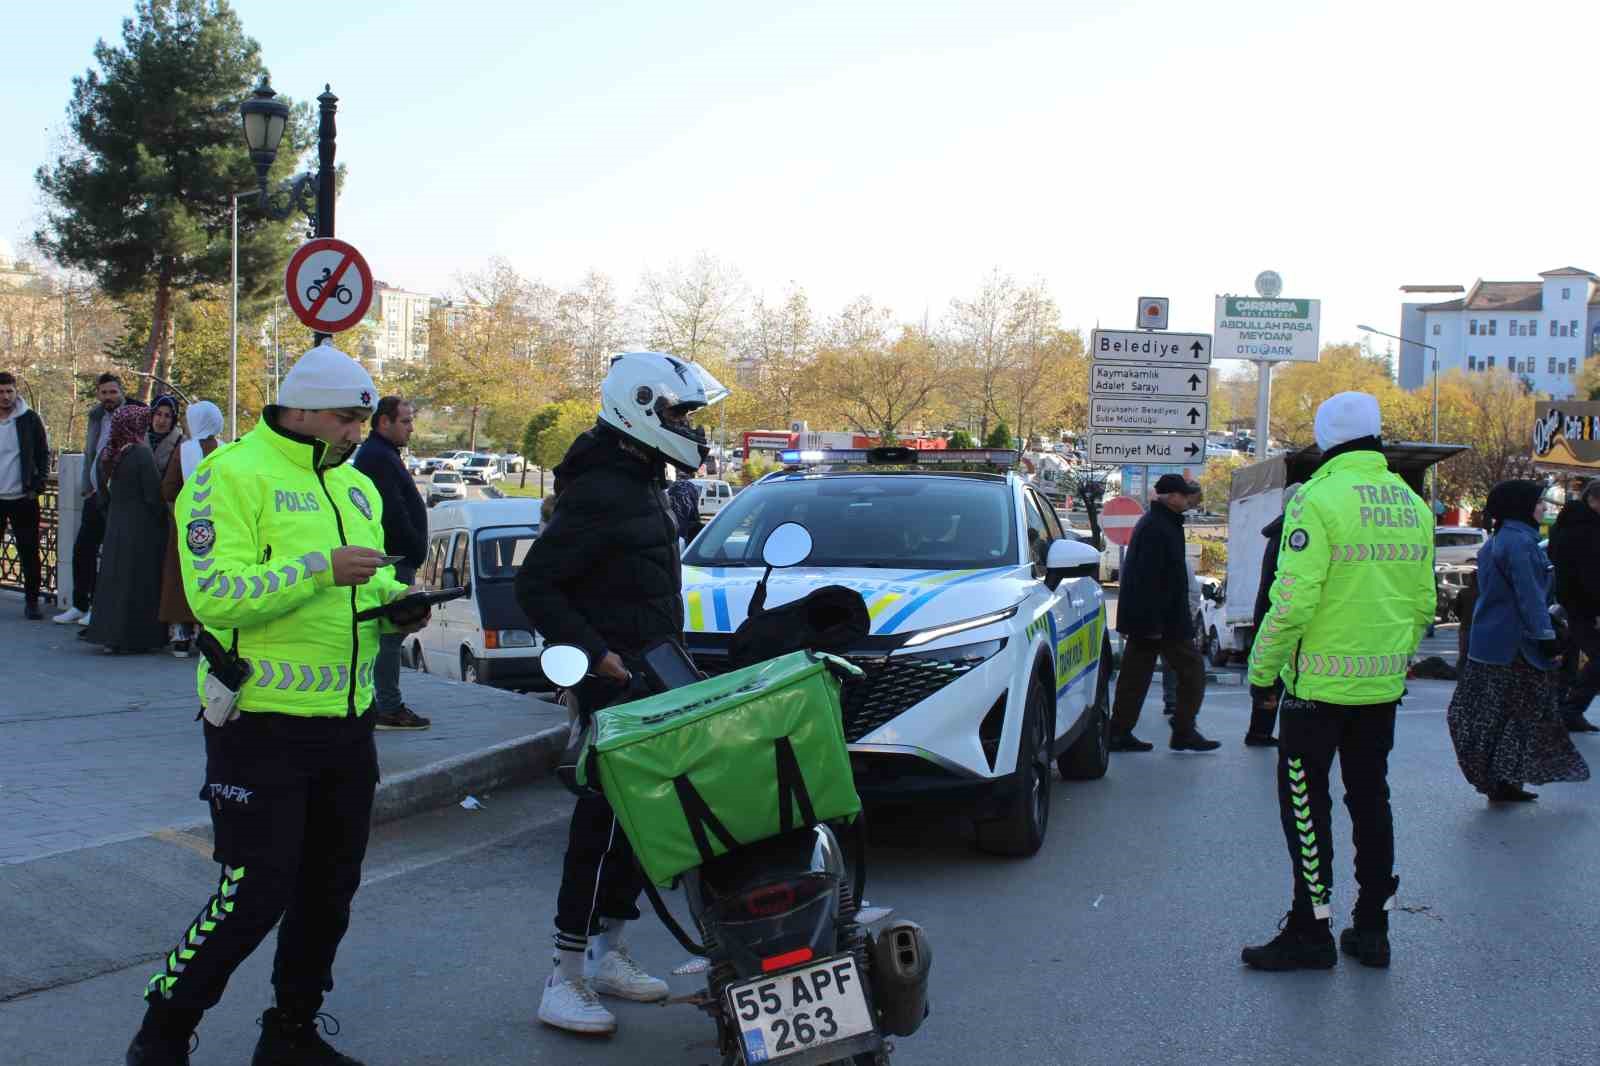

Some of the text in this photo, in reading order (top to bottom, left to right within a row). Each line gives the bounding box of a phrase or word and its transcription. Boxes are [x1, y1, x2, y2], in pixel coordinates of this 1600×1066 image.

[1219, 319, 1281, 330] ABDULLAH
[1100, 336, 1179, 357] Belediye
[1239, 331, 1293, 341] MEYDANI
[1095, 381, 1125, 391] Adalet
[1095, 443, 1141, 458] Emniyet
[274, 489, 320, 513] POLİS
[1359, 506, 1420, 529] POLİSİ
[735, 962, 852, 1022] 55 APF
[770, 1006, 838, 1052] 263
